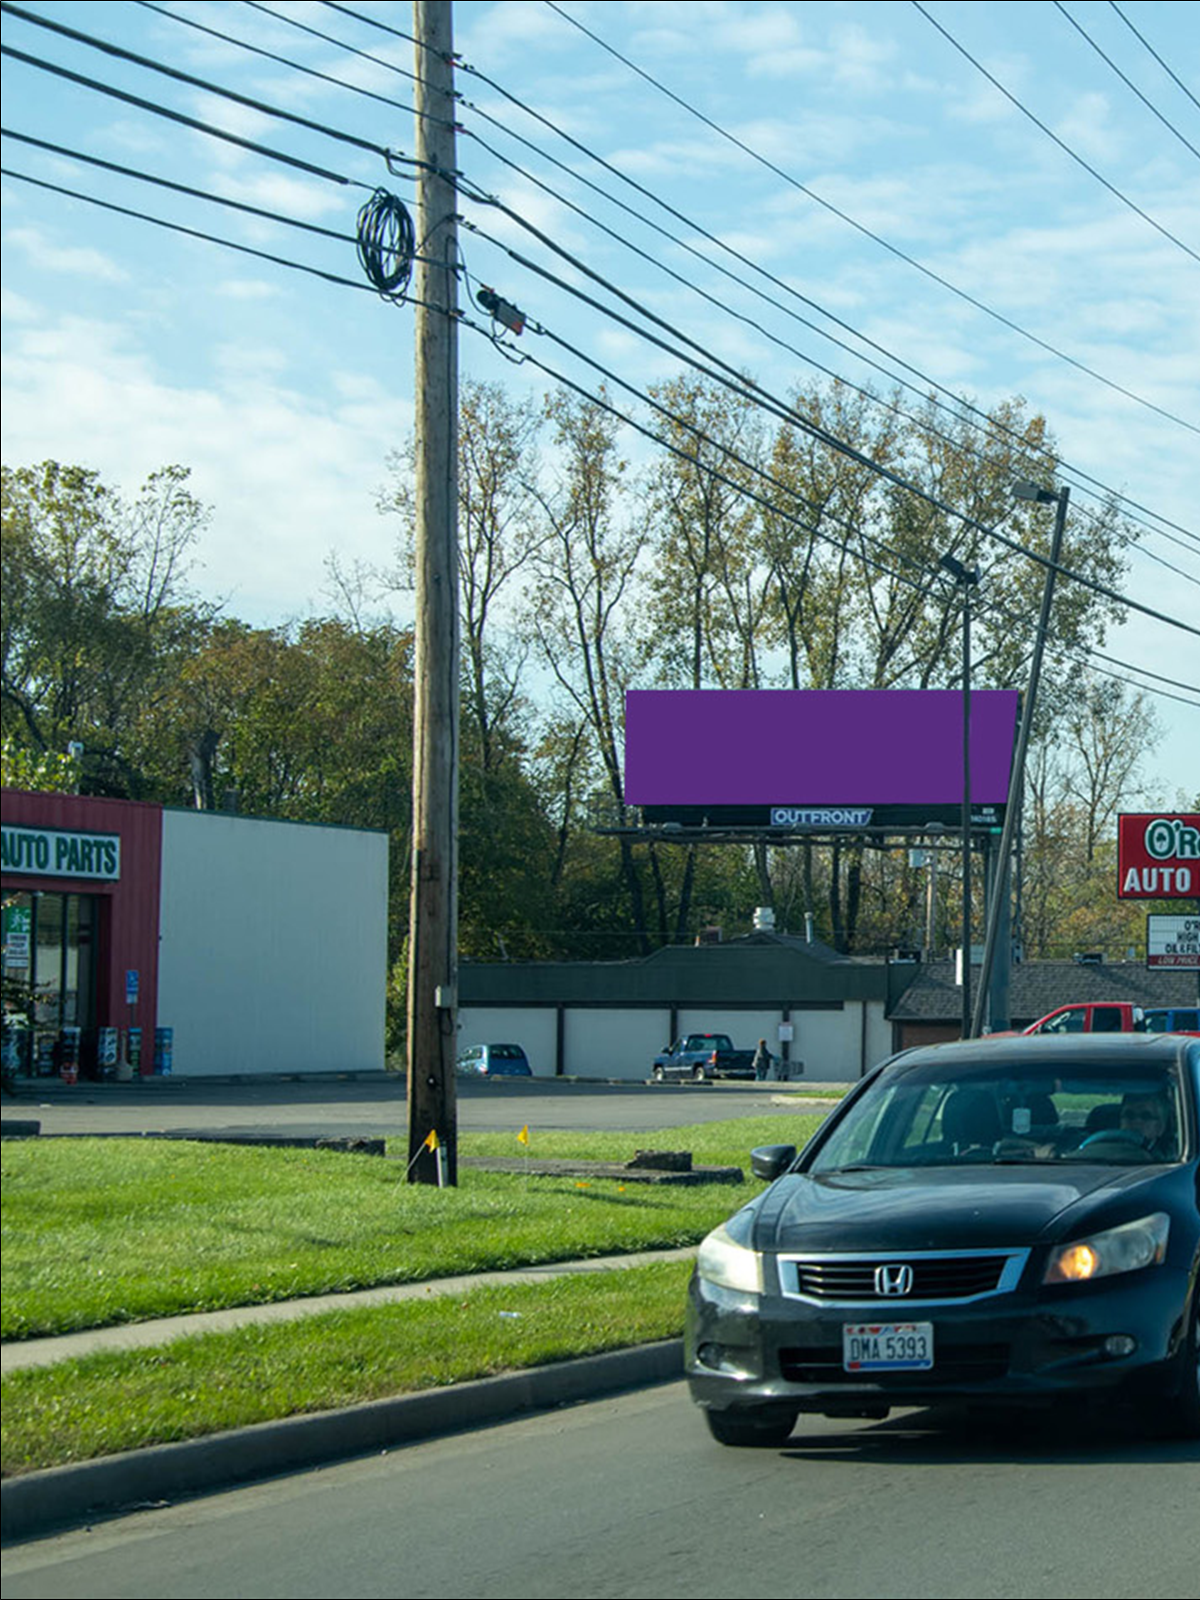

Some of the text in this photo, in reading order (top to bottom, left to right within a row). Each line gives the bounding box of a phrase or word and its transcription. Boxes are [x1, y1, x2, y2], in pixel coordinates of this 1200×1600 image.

[774, 810, 866, 824] OUTFRONT
[56, 836, 117, 875] PARTS
[1123, 867, 1191, 893] AUTO
[1177, 932, 1198, 943] HIGH
[1157, 955, 1175, 965] LOW
[1176, 955, 1198, 965] PRICE
[850, 1337, 927, 1360] DMA 5393
